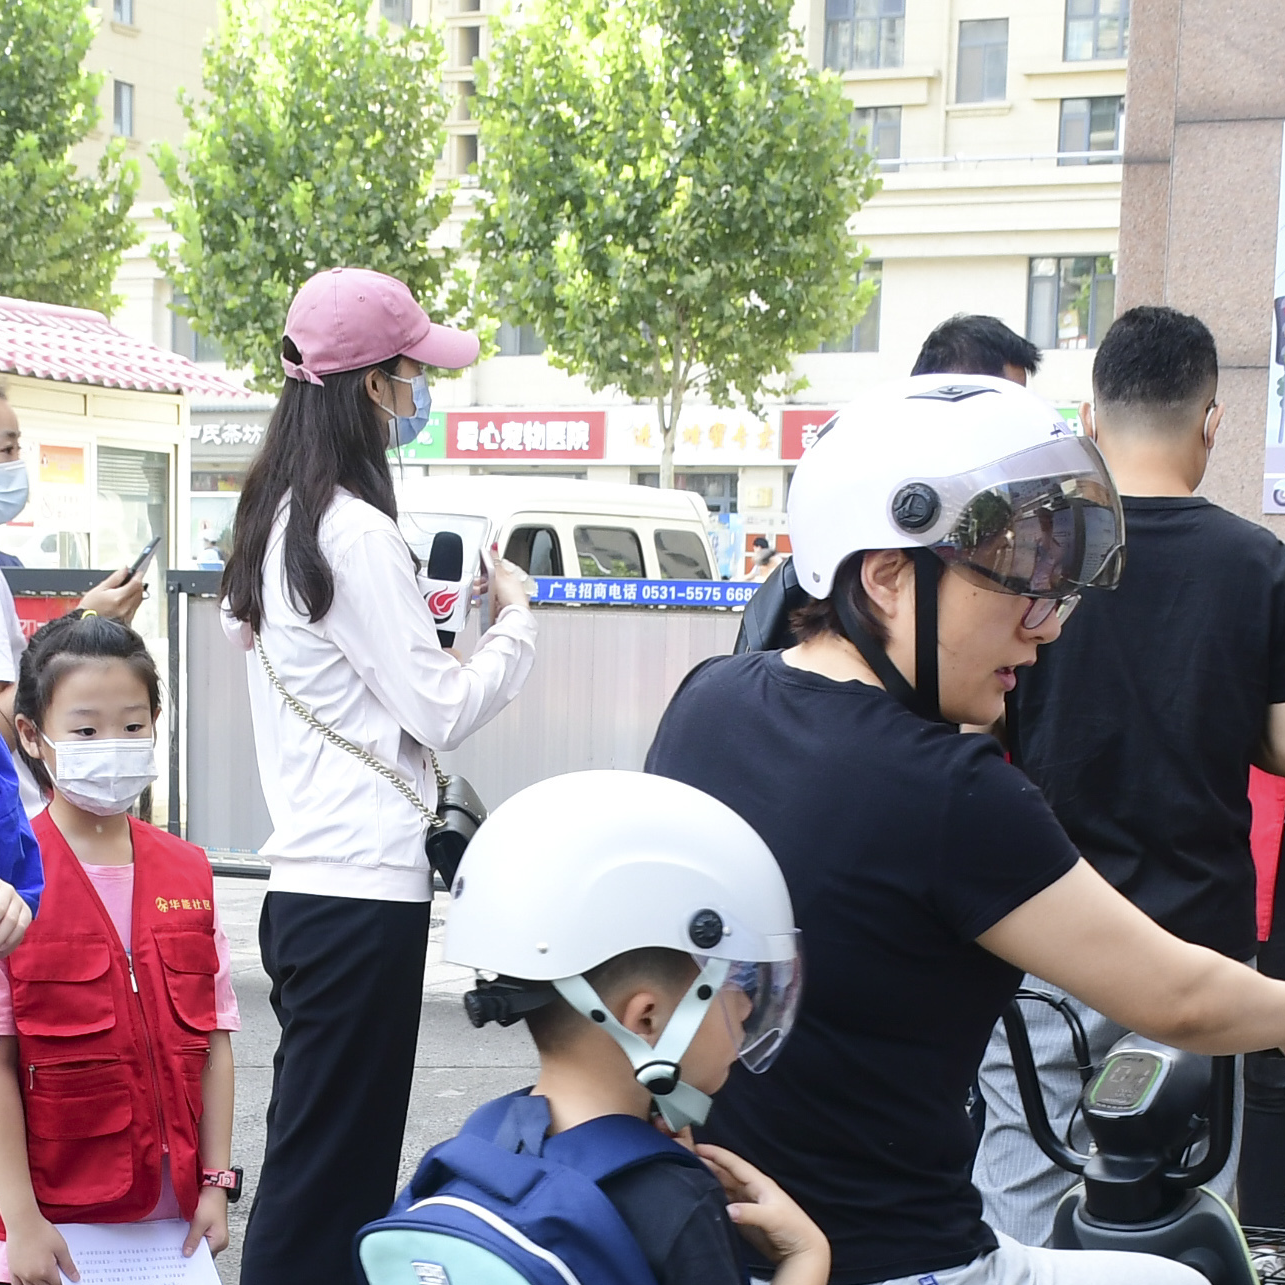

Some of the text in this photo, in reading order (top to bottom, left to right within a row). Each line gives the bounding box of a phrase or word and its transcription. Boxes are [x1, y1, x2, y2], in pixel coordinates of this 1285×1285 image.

[456, 420, 590, 452] 爱心宠物医院
[548, 581, 638, 600] 广告招商电话
[642, 585, 721, 602] 0531-5575
